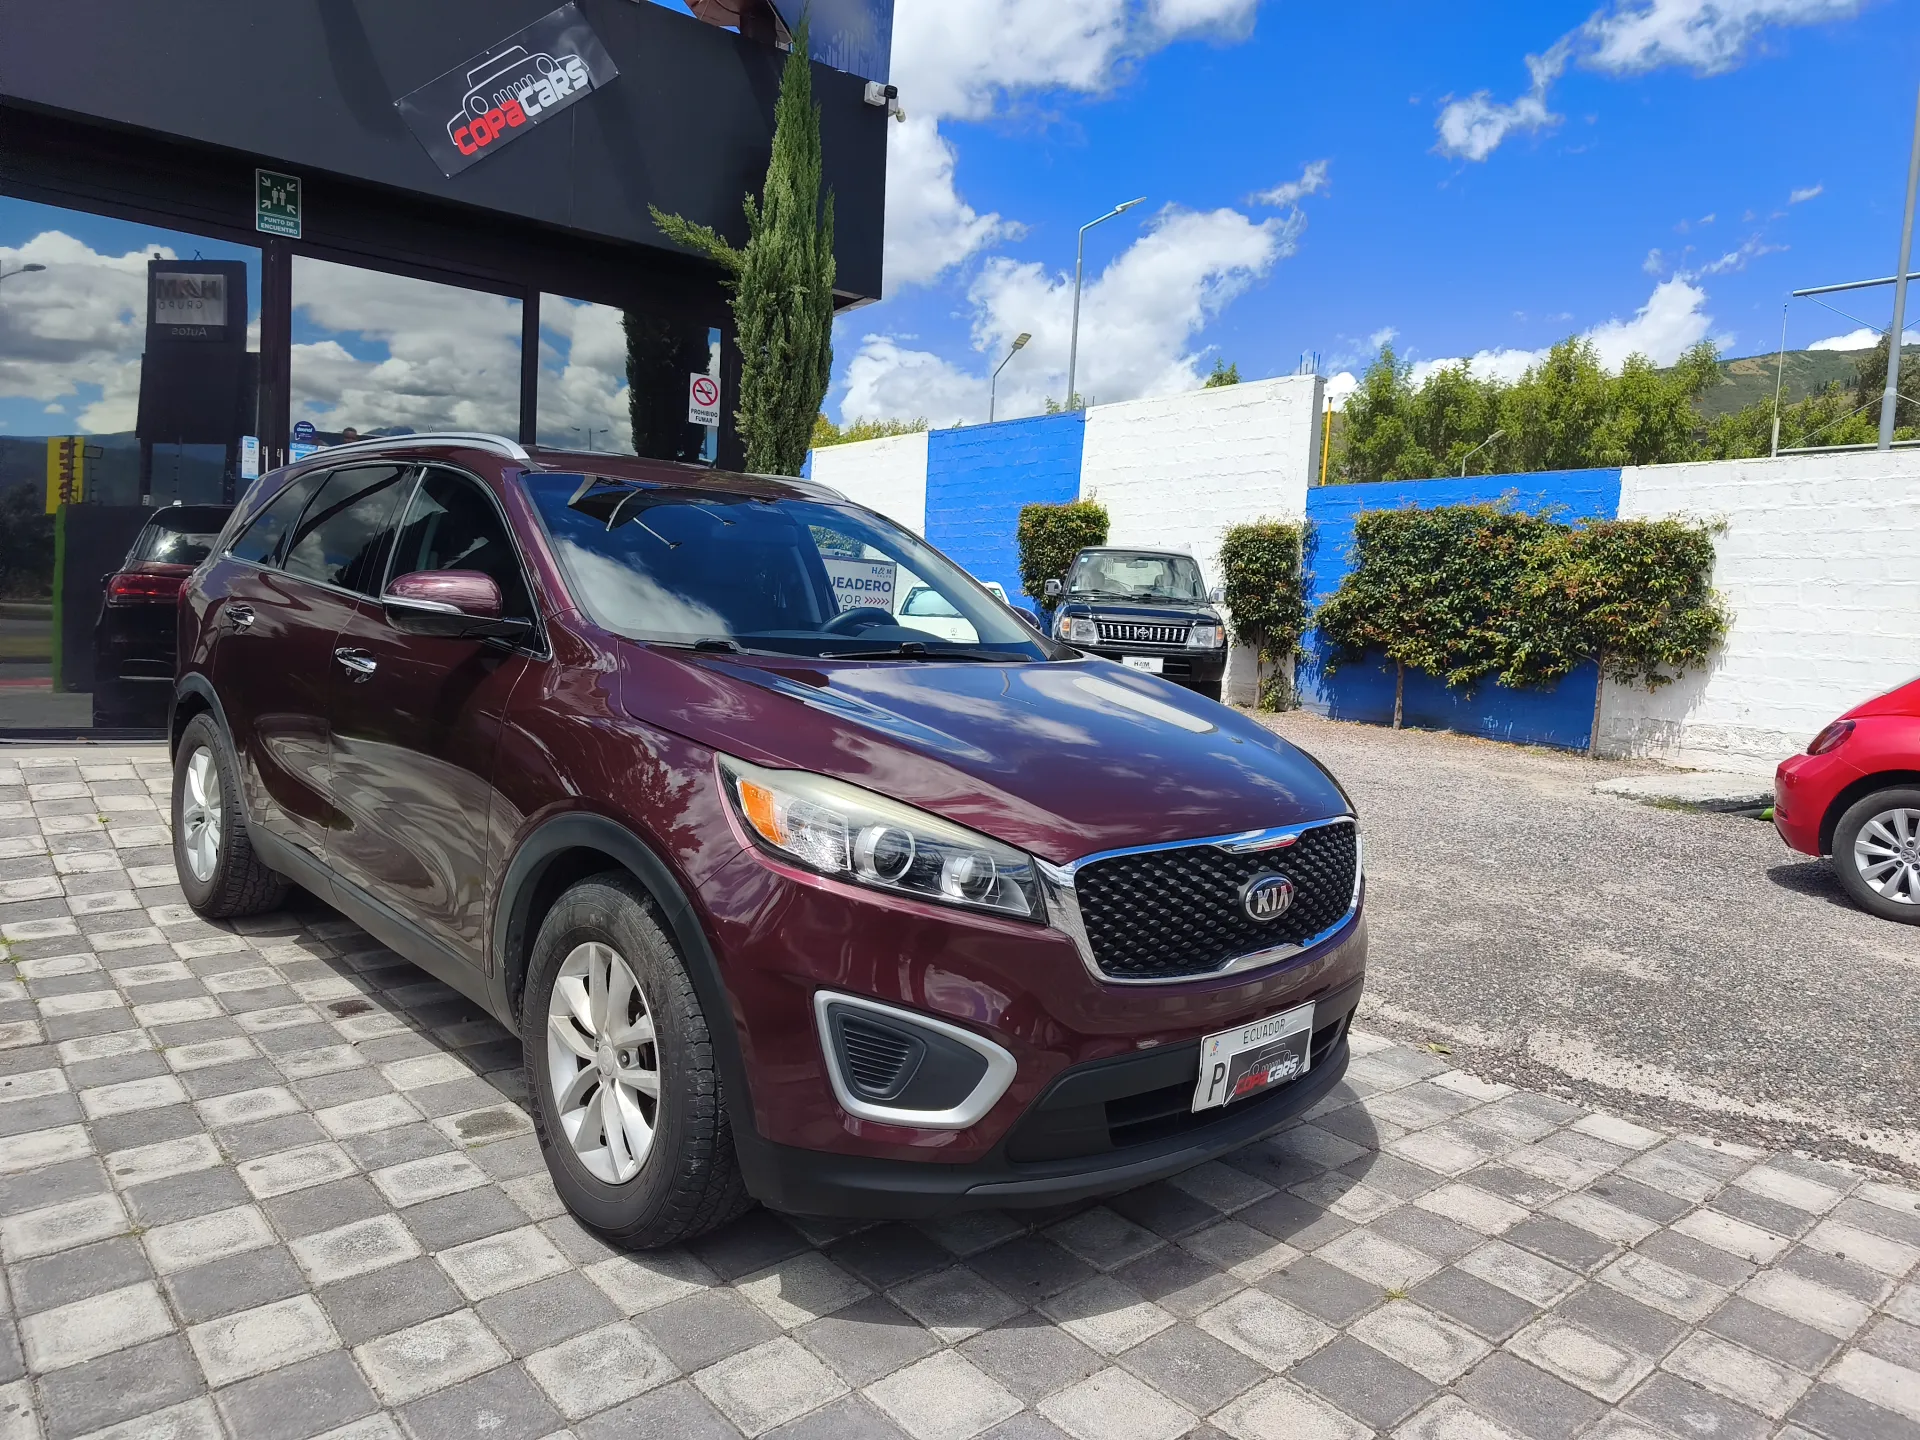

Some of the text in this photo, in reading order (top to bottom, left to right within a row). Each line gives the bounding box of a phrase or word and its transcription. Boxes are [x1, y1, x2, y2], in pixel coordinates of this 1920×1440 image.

[264, 216, 285, 226] PUNTO
[261, 222, 298, 235] ENCUENTRO
[690, 408, 719, 418] PROHIBIDO
[695, 415, 713, 424] FUMAR
[1257, 884, 1289, 914] KIA
[1243, 1018, 1286, 1045] ECUADOR
[1207, 1062, 1226, 1103] P
